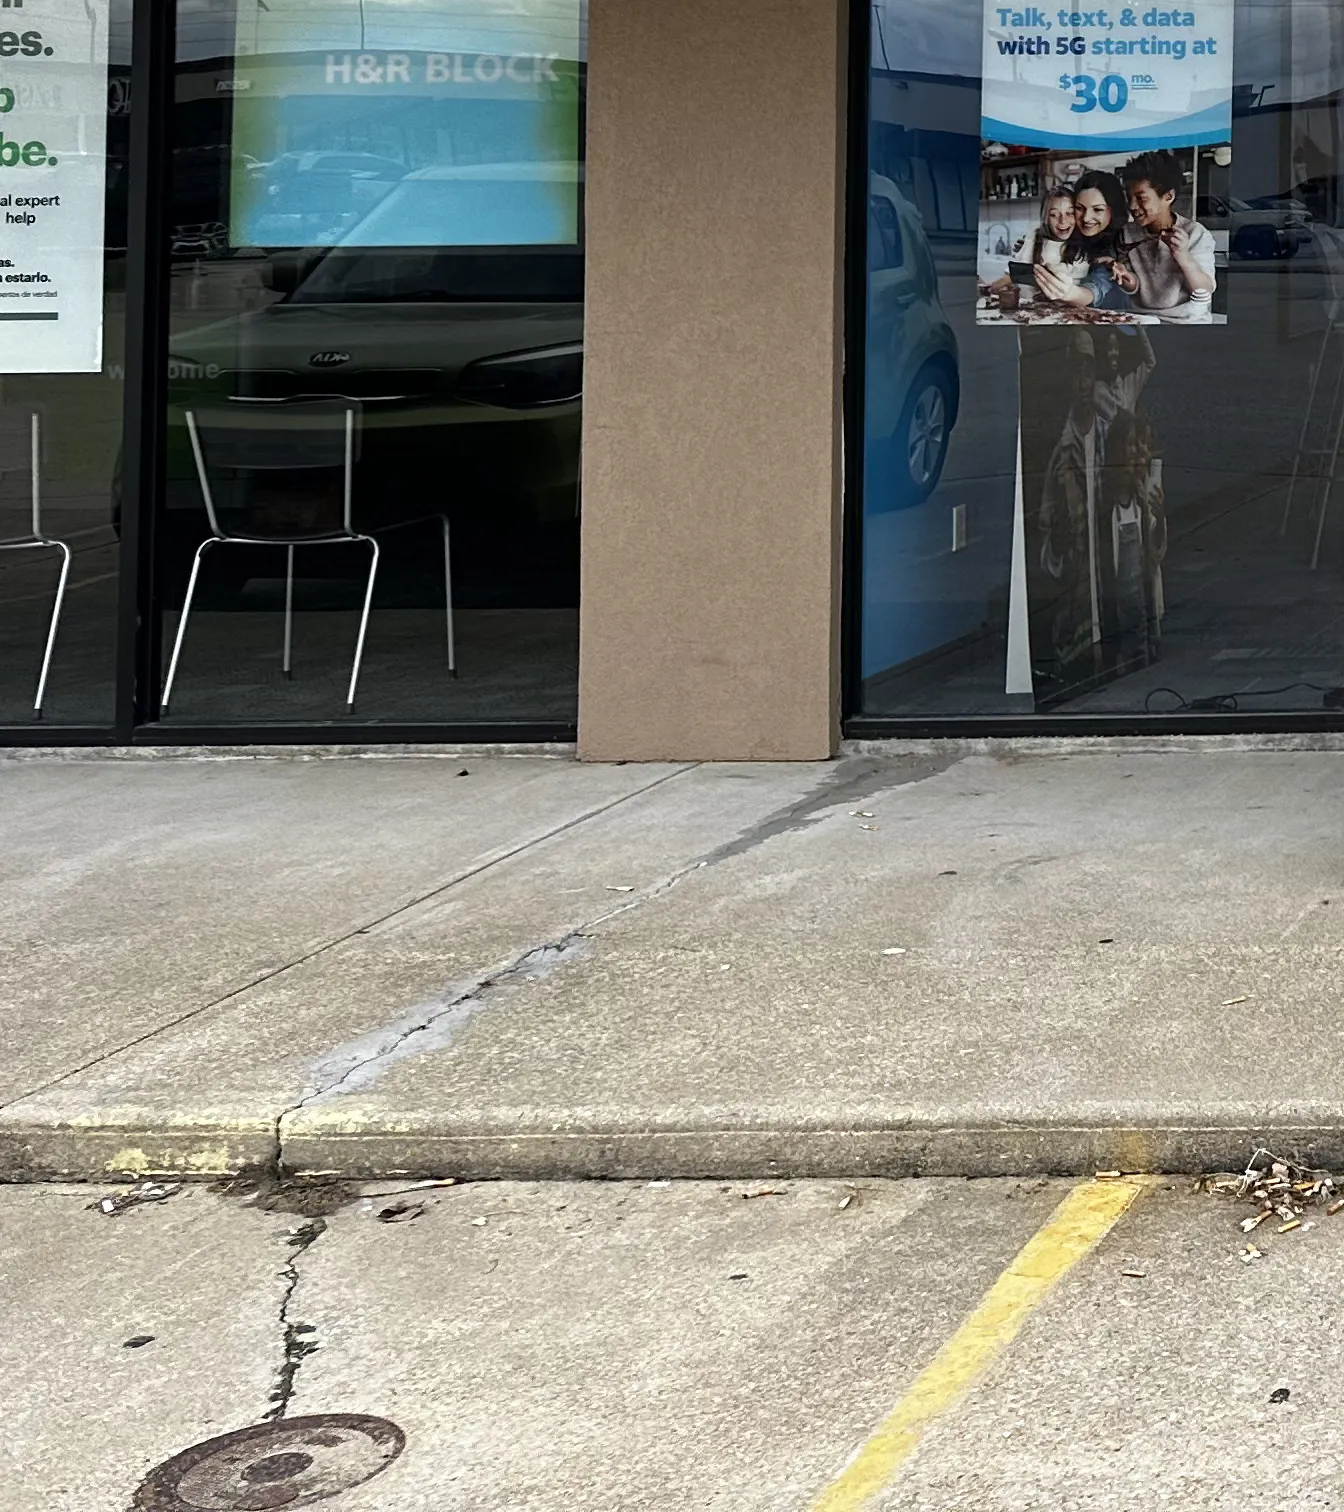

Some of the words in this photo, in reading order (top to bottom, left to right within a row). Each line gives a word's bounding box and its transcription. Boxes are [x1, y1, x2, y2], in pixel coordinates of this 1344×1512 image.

[996, 7, 1052, 31] Talk,
[1057, 9, 1114, 31] text,
[1119, 8, 1138, 28] &
[1142, 7, 1196, 28] data
[997, 36, 1050, 56] with
[1055, 36, 1086, 56] 5G
[1091, 36, 1187, 60] starting
[1191, 37, 1217, 56] at
[325, 54, 410, 84] H&R
[425, 52, 560, 84] BLOCK
[1059, 73, 1129, 114] $30
[1131, 75, 1156, 84] mo.
[15, 195, 60, 209] expert
[6, 212, 36, 226] help
[5, 272, 51, 283] estarlo.
